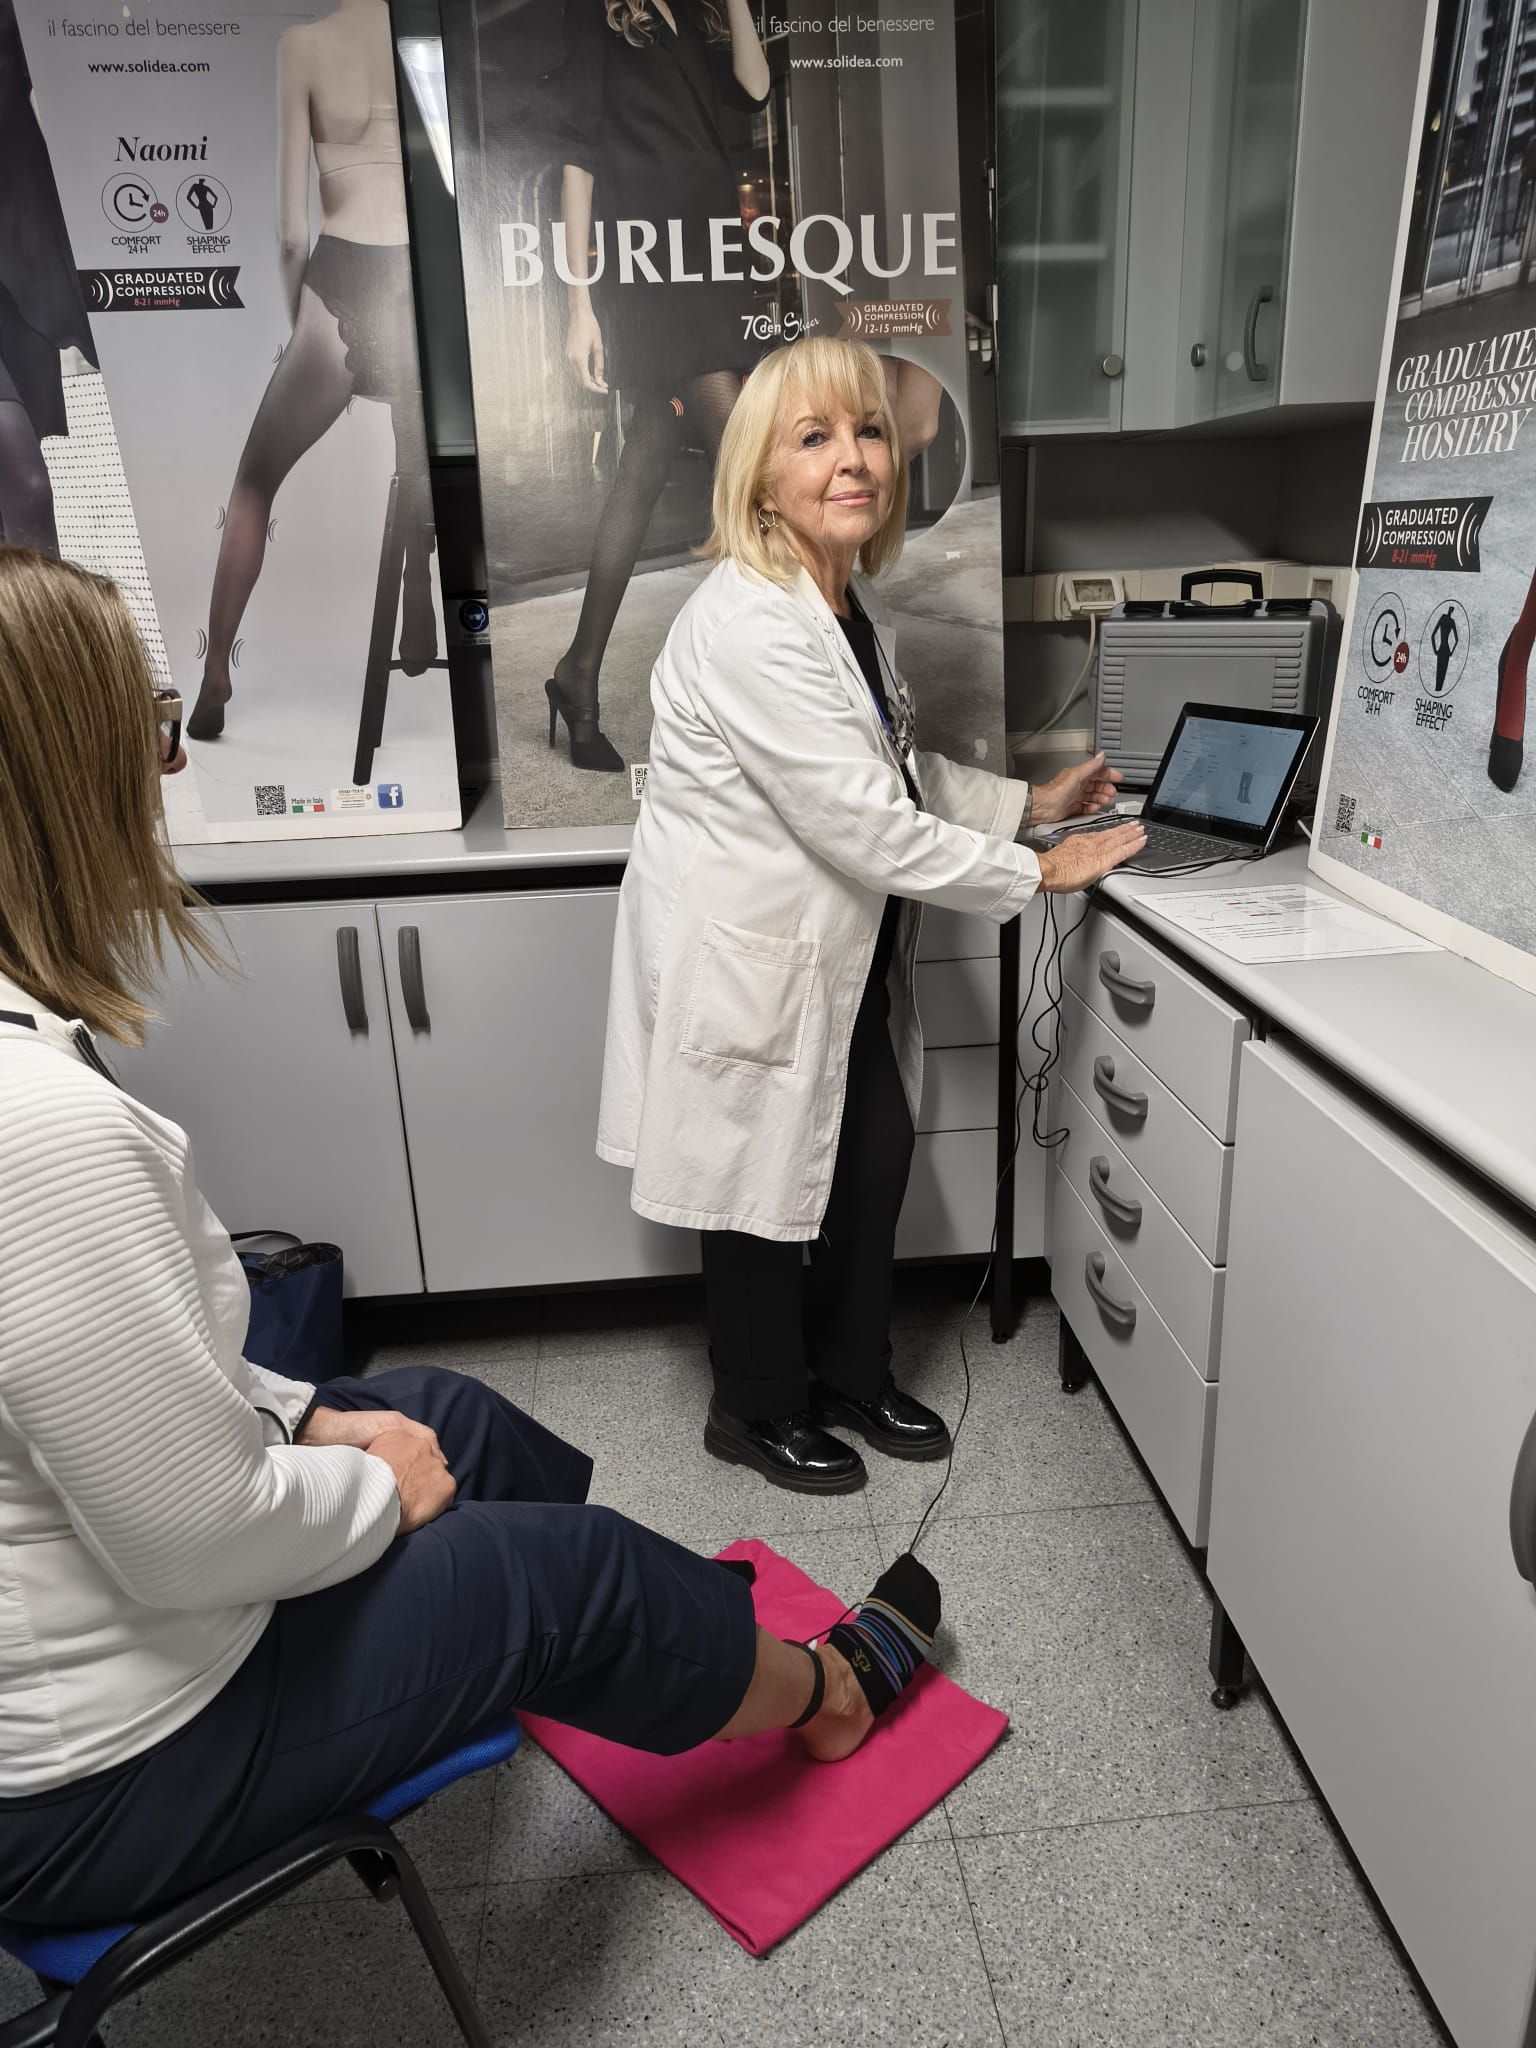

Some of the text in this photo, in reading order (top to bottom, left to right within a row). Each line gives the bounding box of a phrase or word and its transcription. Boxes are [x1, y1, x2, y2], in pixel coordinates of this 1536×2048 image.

[48, 18, 241, 37] il fascino del benessere
[756, 16, 935, 33] il fascino del benessere
[88, 60, 210, 73] www.solidea.com
[790, 55, 903, 69] www.solidea.com
[113, 135, 208, 162] Naomi
[111, 236, 162, 246] COMFORT
[186, 235, 231, 246] SHAPING
[192, 245, 228, 254] EFFECT
[499, 212, 958, 296] BURLESQUE
[114, 271, 204, 285] GRADUATED
[115, 285, 206, 297] COMPRESSION
[154, 298, 181, 308] mmHg
[864, 303, 924, 313] GRADUATED
[864, 312, 924, 321] COMPRESSION
[864, 323, 923, 335] 12-15 mmHg
[1396, 328, 1536, 393] GRADUATE
[1400, 407, 1533, 463] HOSIERY
[1385, 507, 1458, 526] GRADUATED
[1382, 530, 1456, 545] COMPRESSION
[1410, 550, 1437, 569] mmHg
[1357, 686, 1395, 705] COMFORT
[1415, 698, 1454, 719] SHAPING
[1415, 714, 1448, 732] EFFECT
